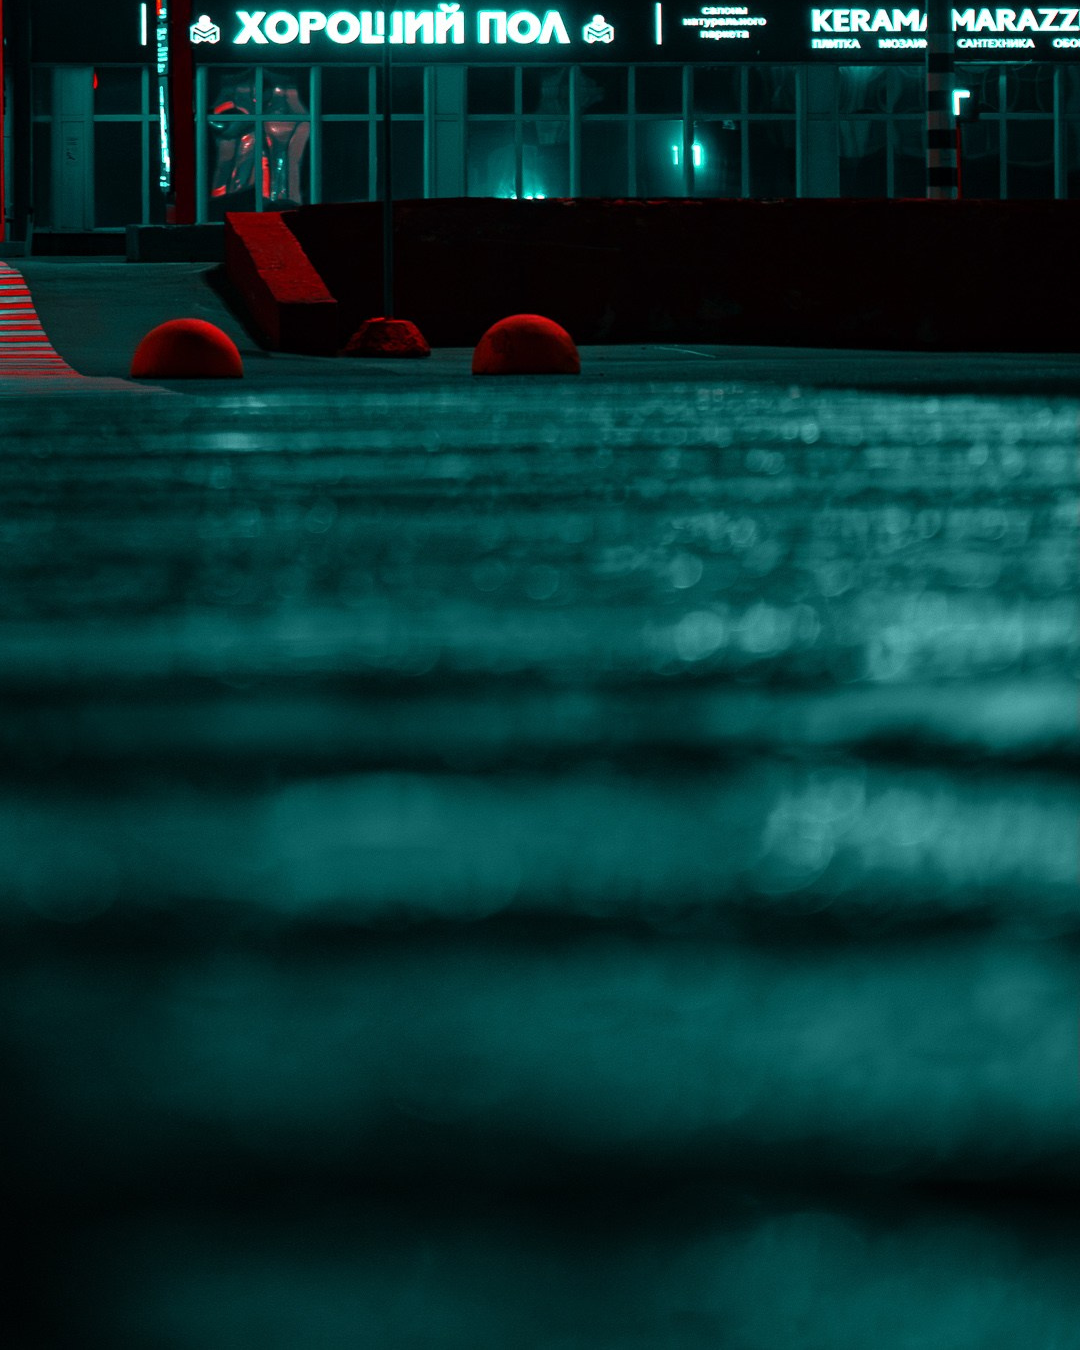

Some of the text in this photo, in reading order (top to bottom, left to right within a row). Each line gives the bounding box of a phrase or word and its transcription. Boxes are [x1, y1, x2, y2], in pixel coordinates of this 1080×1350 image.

[234, 3, 571, 45] ХОРОШИЙ ПОЛ
[951, 8, 1080, 32] MARAZZ
[811, 38, 861, 49] ПЛИТКА
[956, 38, 1036, 49] САНТЕХНИКА
[1052, 38, 1080, 49] ОБО
